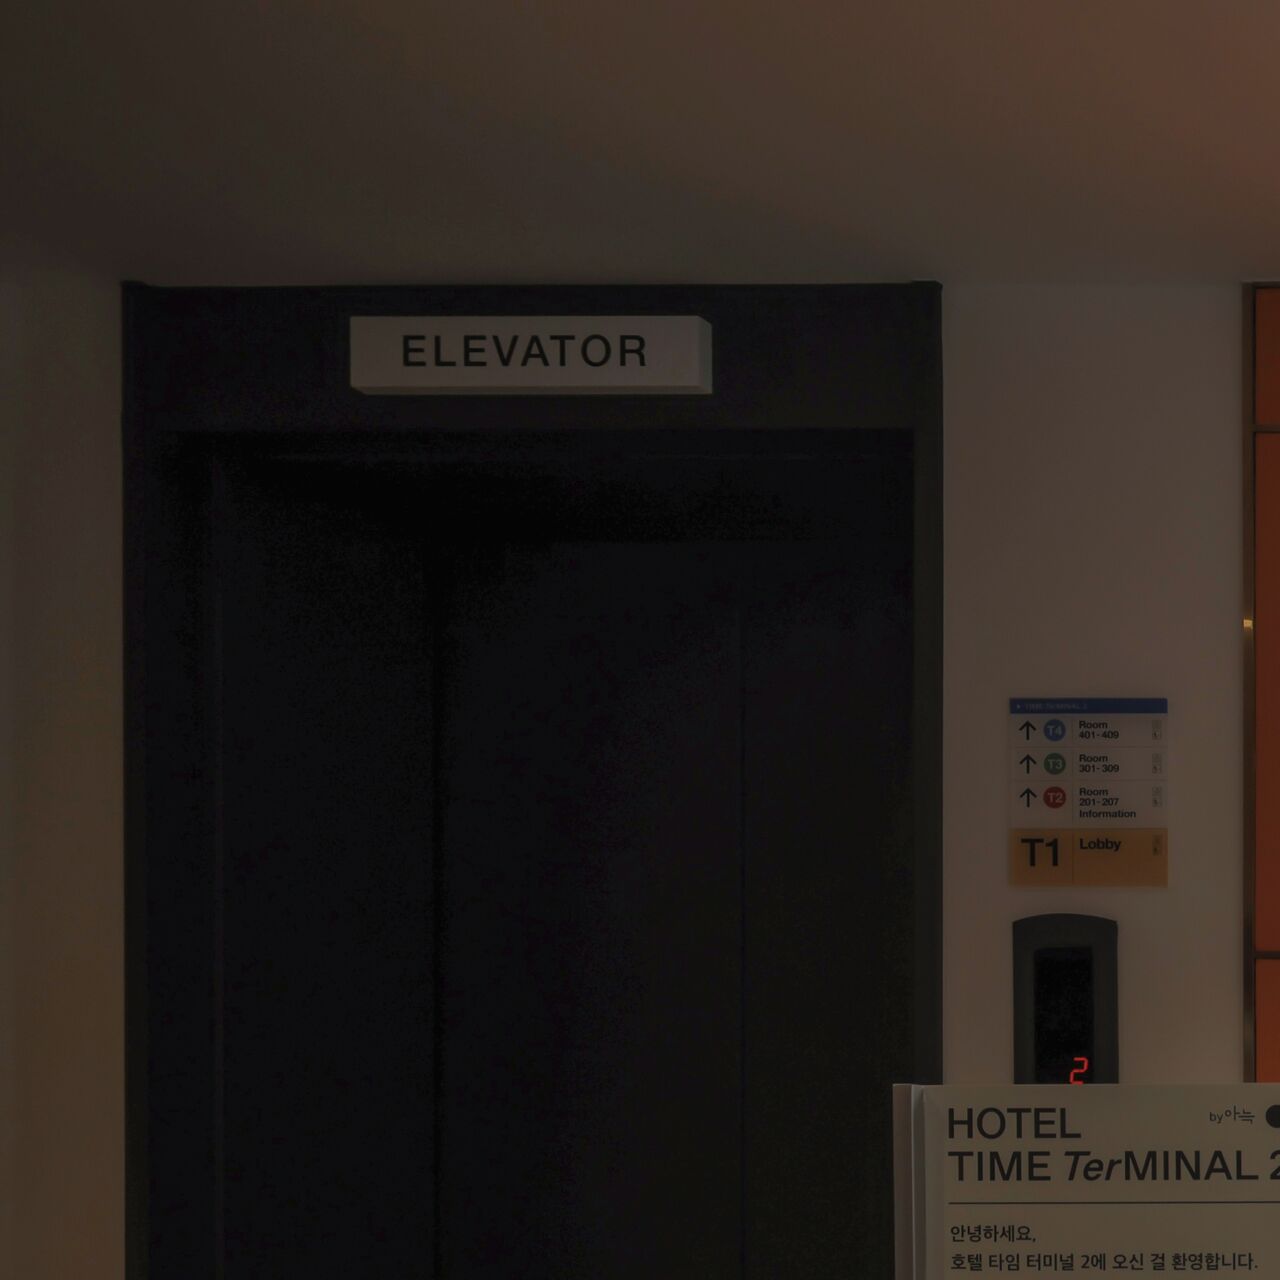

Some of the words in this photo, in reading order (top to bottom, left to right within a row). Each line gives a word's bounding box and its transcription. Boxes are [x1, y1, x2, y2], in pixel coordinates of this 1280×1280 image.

[402, 334, 646, 367] ELEVATOR
[1047, 724, 1064, 737] T4
[1079, 720, 1108, 729] Room
[1048, 759, 1062, 769] T3
[1079, 754, 1108, 762] Room
[1048, 793, 1063, 803] T2
[1079, 787, 1109, 796] Room
[1079, 809, 1136, 818] Information
[1080, 838, 1122, 852] Lobby
[1021, 838, 1058, 867] T1
[1070, 1057, 1088, 1084] 2
[948, 1107, 1082, 1139] HOTEL
[948, 1151, 1051, 1181] TIME
[1064, 1150, 1259, 1181] TerMINAL
[950, 1224, 1036, 1243] 안녕하세요,
[951, 1253, 983, 1271] 호텔
[989, 1253, 1020, 1271] 타임
[1026, 1253, 1074, 1271] 터미널
[1081, 1253, 1106, 1271] 2에
[1112, 1253, 1144, 1271] 오신
[1150, 1253, 1165, 1271] 걸
[1171, 1252, 1258, 1271] 환영합니다.
